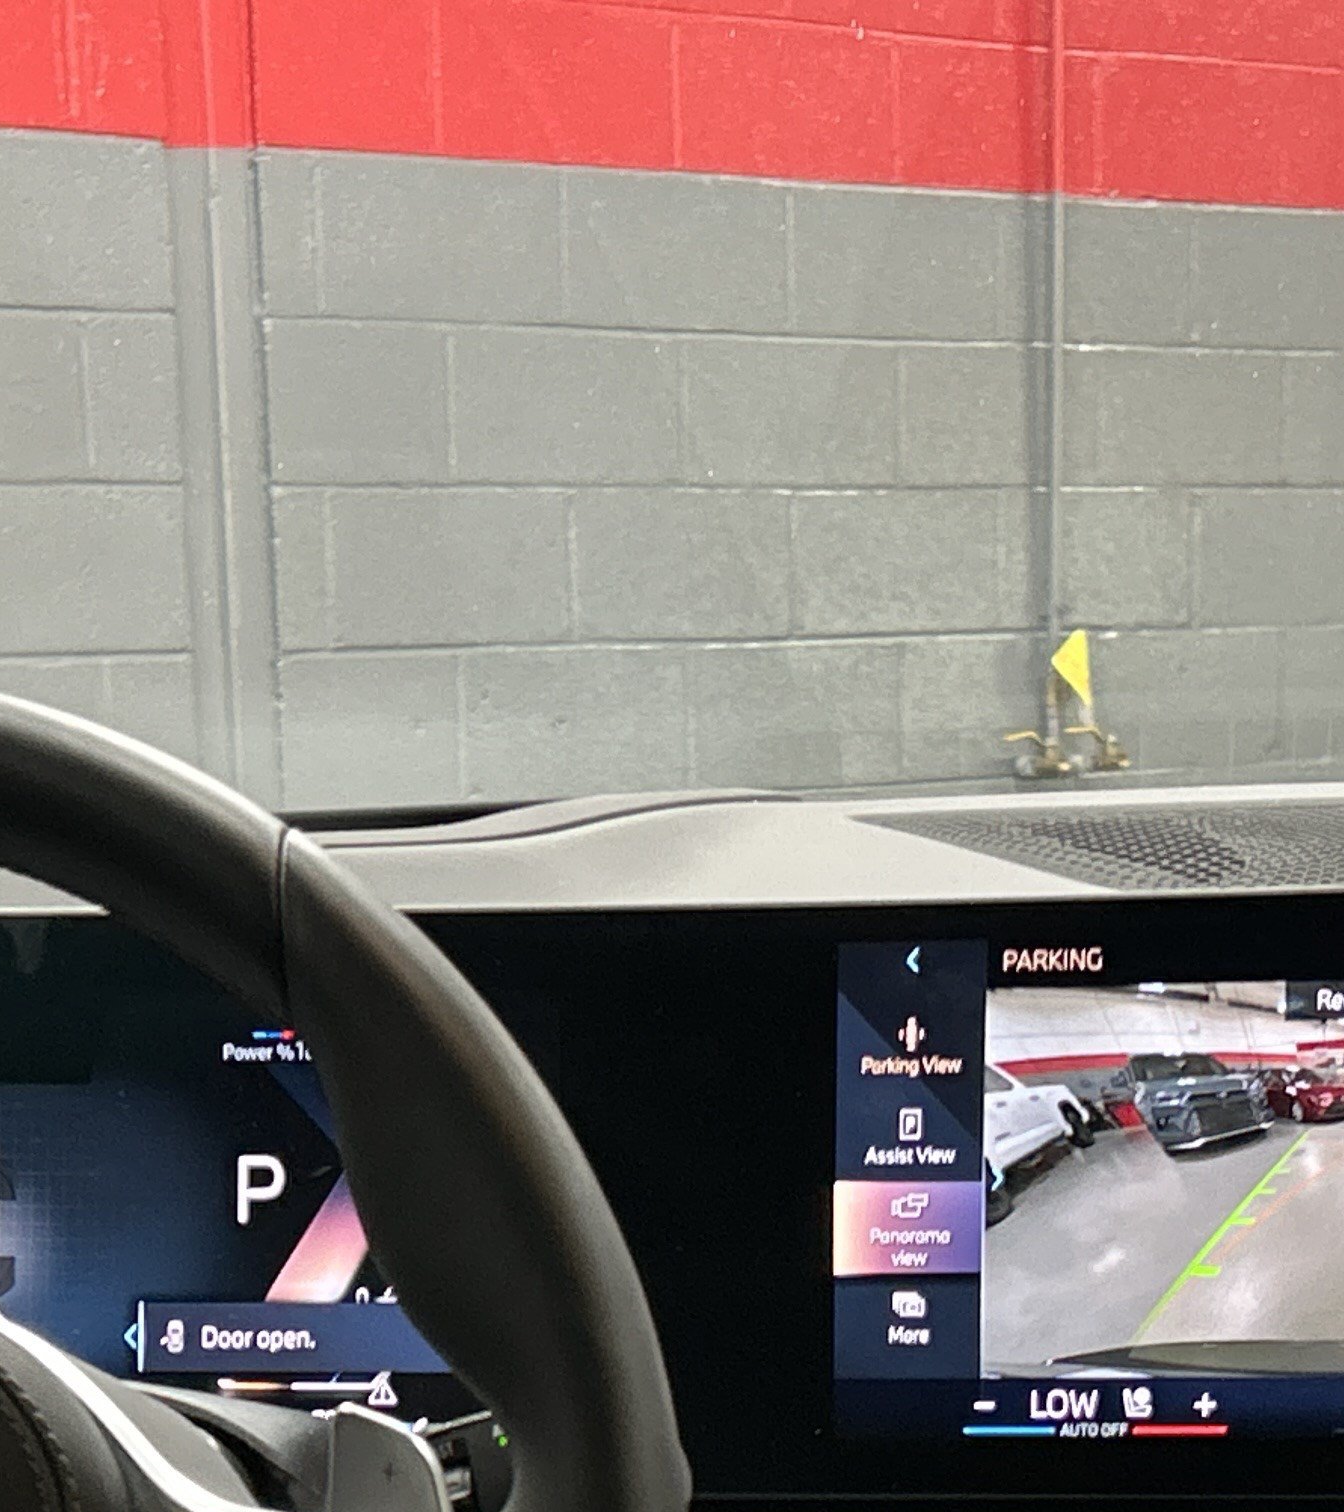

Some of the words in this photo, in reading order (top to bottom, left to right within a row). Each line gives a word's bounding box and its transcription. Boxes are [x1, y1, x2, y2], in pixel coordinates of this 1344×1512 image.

[1002, 947, 1103, 973] PARKING
[222, 1042, 273, 1062] Power
[860, 1056, 920, 1077] Parking
[922, 1055, 963, 1075] View
[863, 1145, 914, 1166] Assist
[916, 1145, 957, 1165] View
[236, 1154, 286, 1225] P
[869, 1226, 952, 1245] Panorama
[890, 1249, 928, 1267] view
[200, 1324, 254, 1350] Door
[256, 1329, 317, 1354] open.
[887, 1325, 930, 1345] More
[1029, 1388, 1099, 1420] LOW
[1059, 1422, 1098, 1439] AUTO
[1101, 1422, 1129, 1438] OFF
